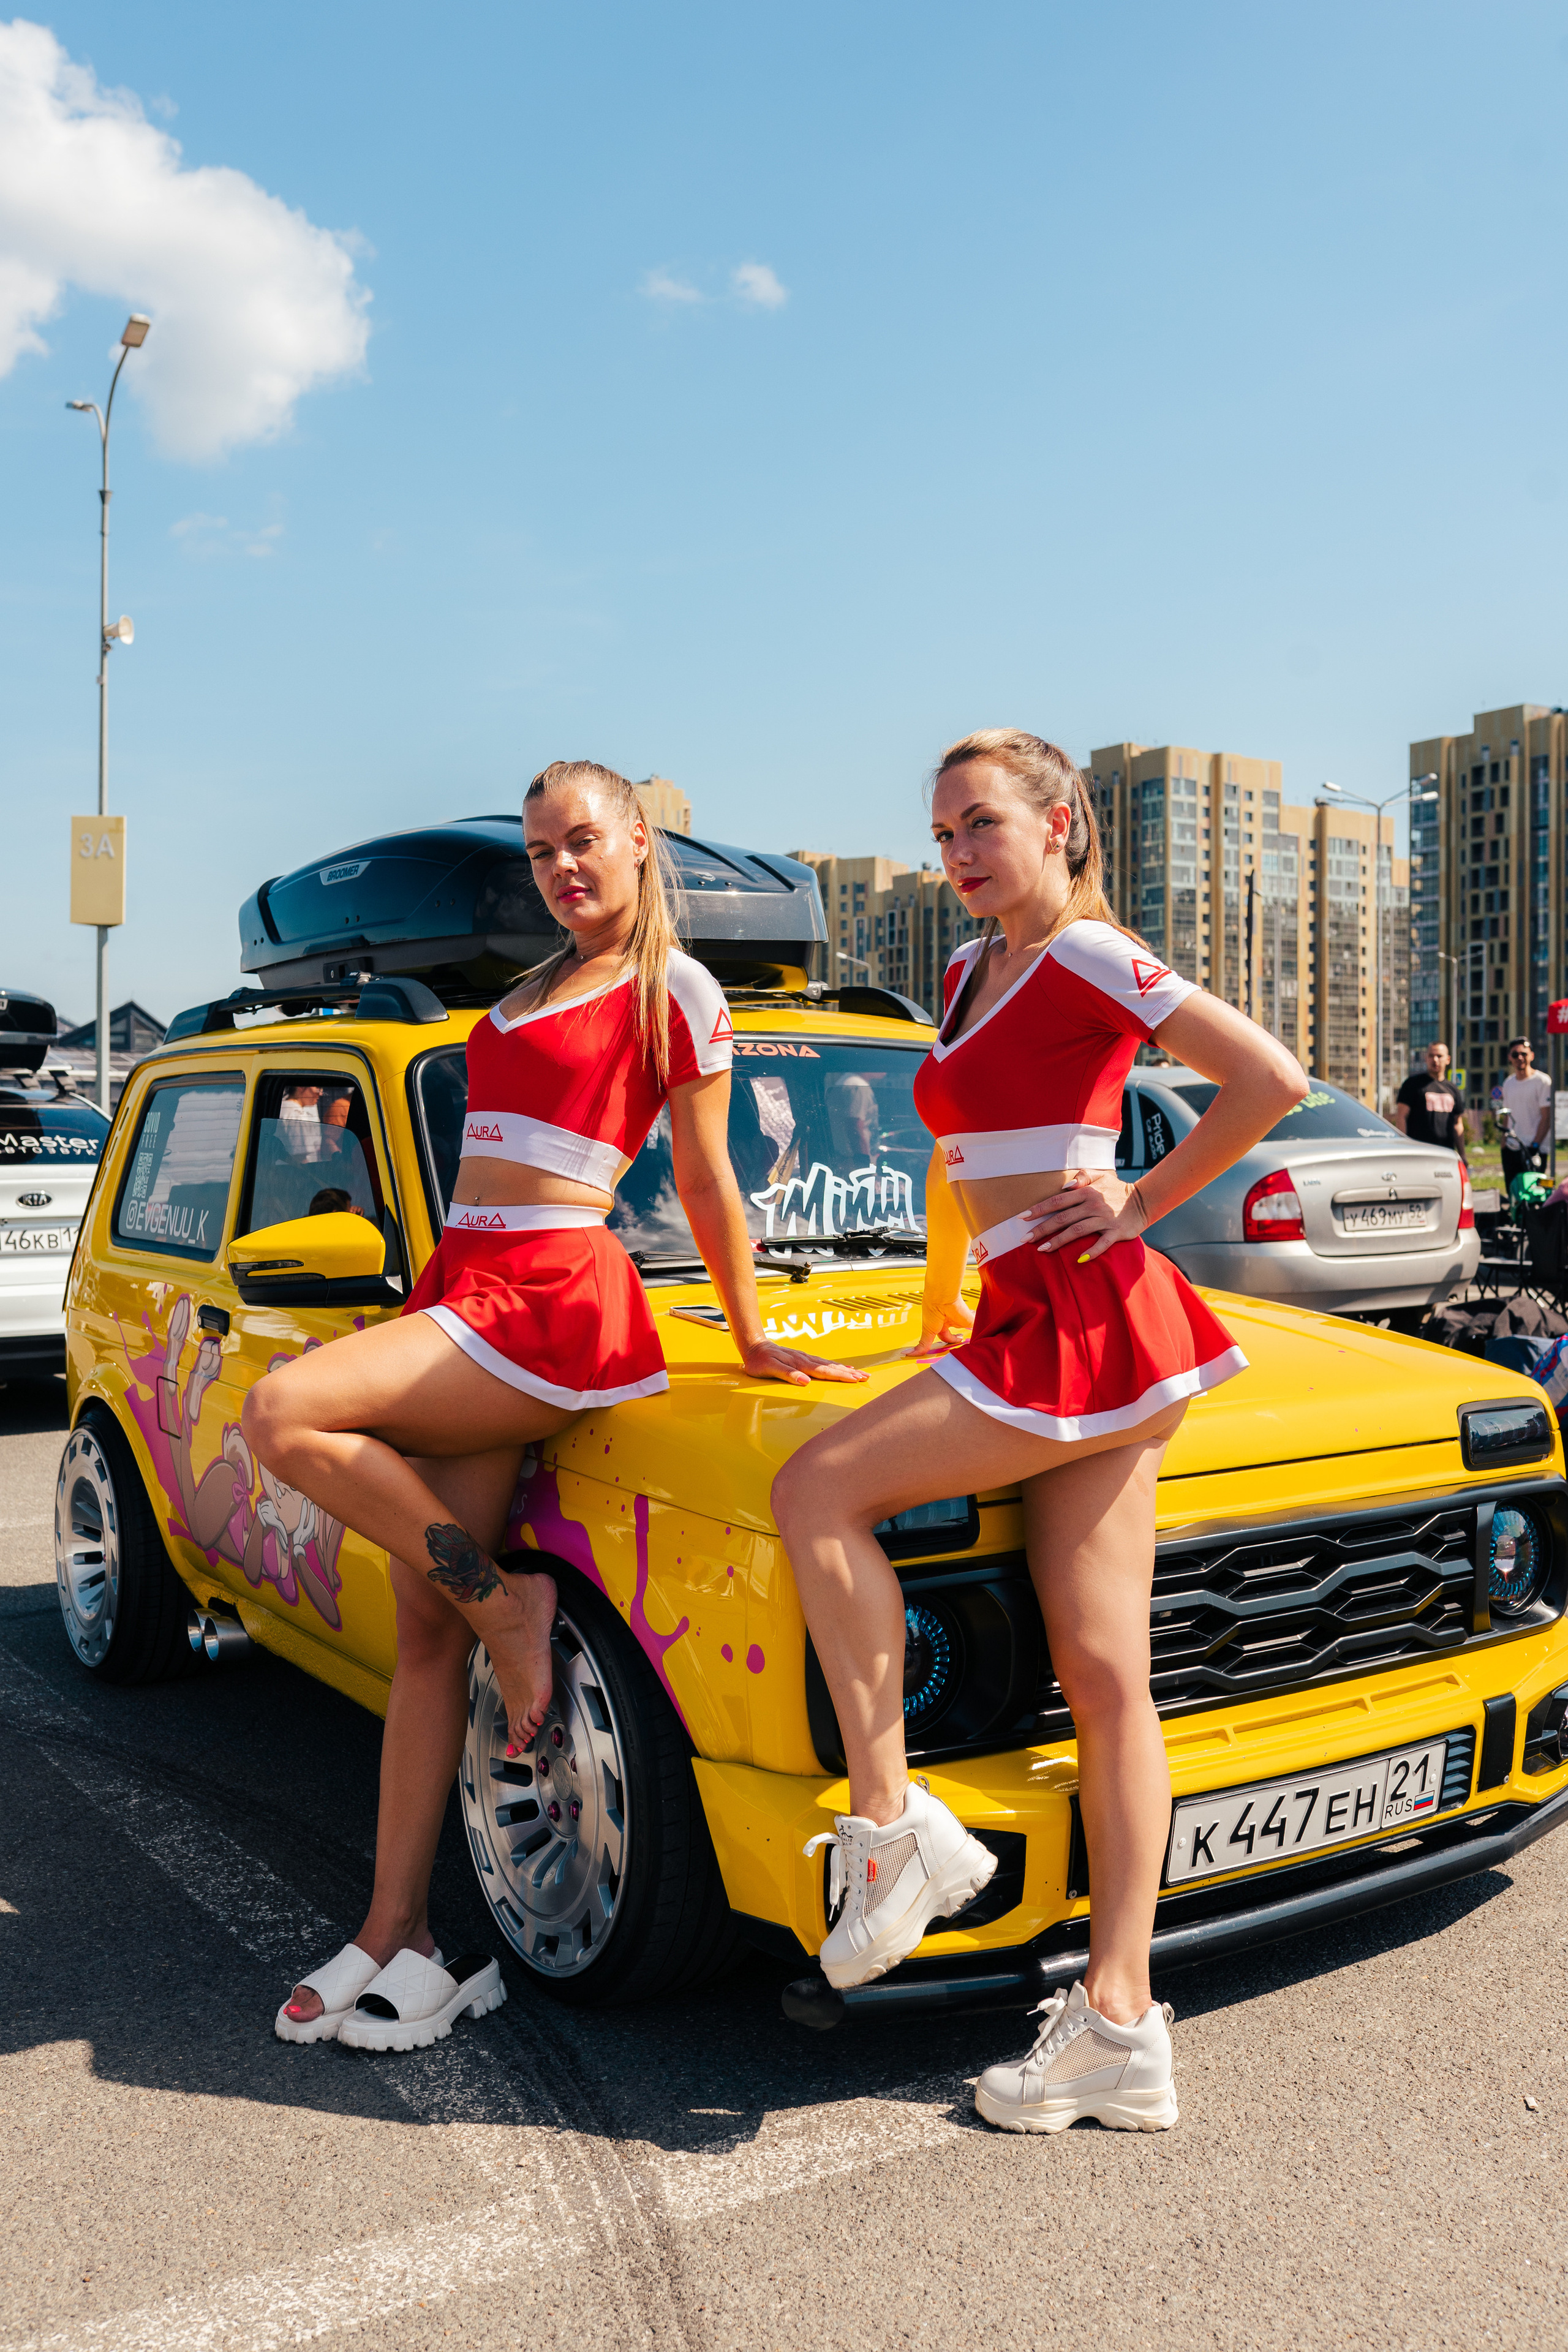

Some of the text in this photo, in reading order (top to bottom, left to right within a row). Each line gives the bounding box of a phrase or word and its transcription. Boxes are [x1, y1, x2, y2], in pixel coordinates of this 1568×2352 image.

[326, 864, 360, 882] BROOMER
[144, 1112, 160, 1134] COVID
[466, 1123, 503, 1142] AURA
[141, 1134, 157, 1148] FREE
[944, 1145, 965, 1166] URA
[23, 1194, 48, 1205] KIA
[455, 1212, 507, 1229] AURA
[1390, 1753, 1430, 1802] 21
[1385, 1799, 1412, 1820] RUS
